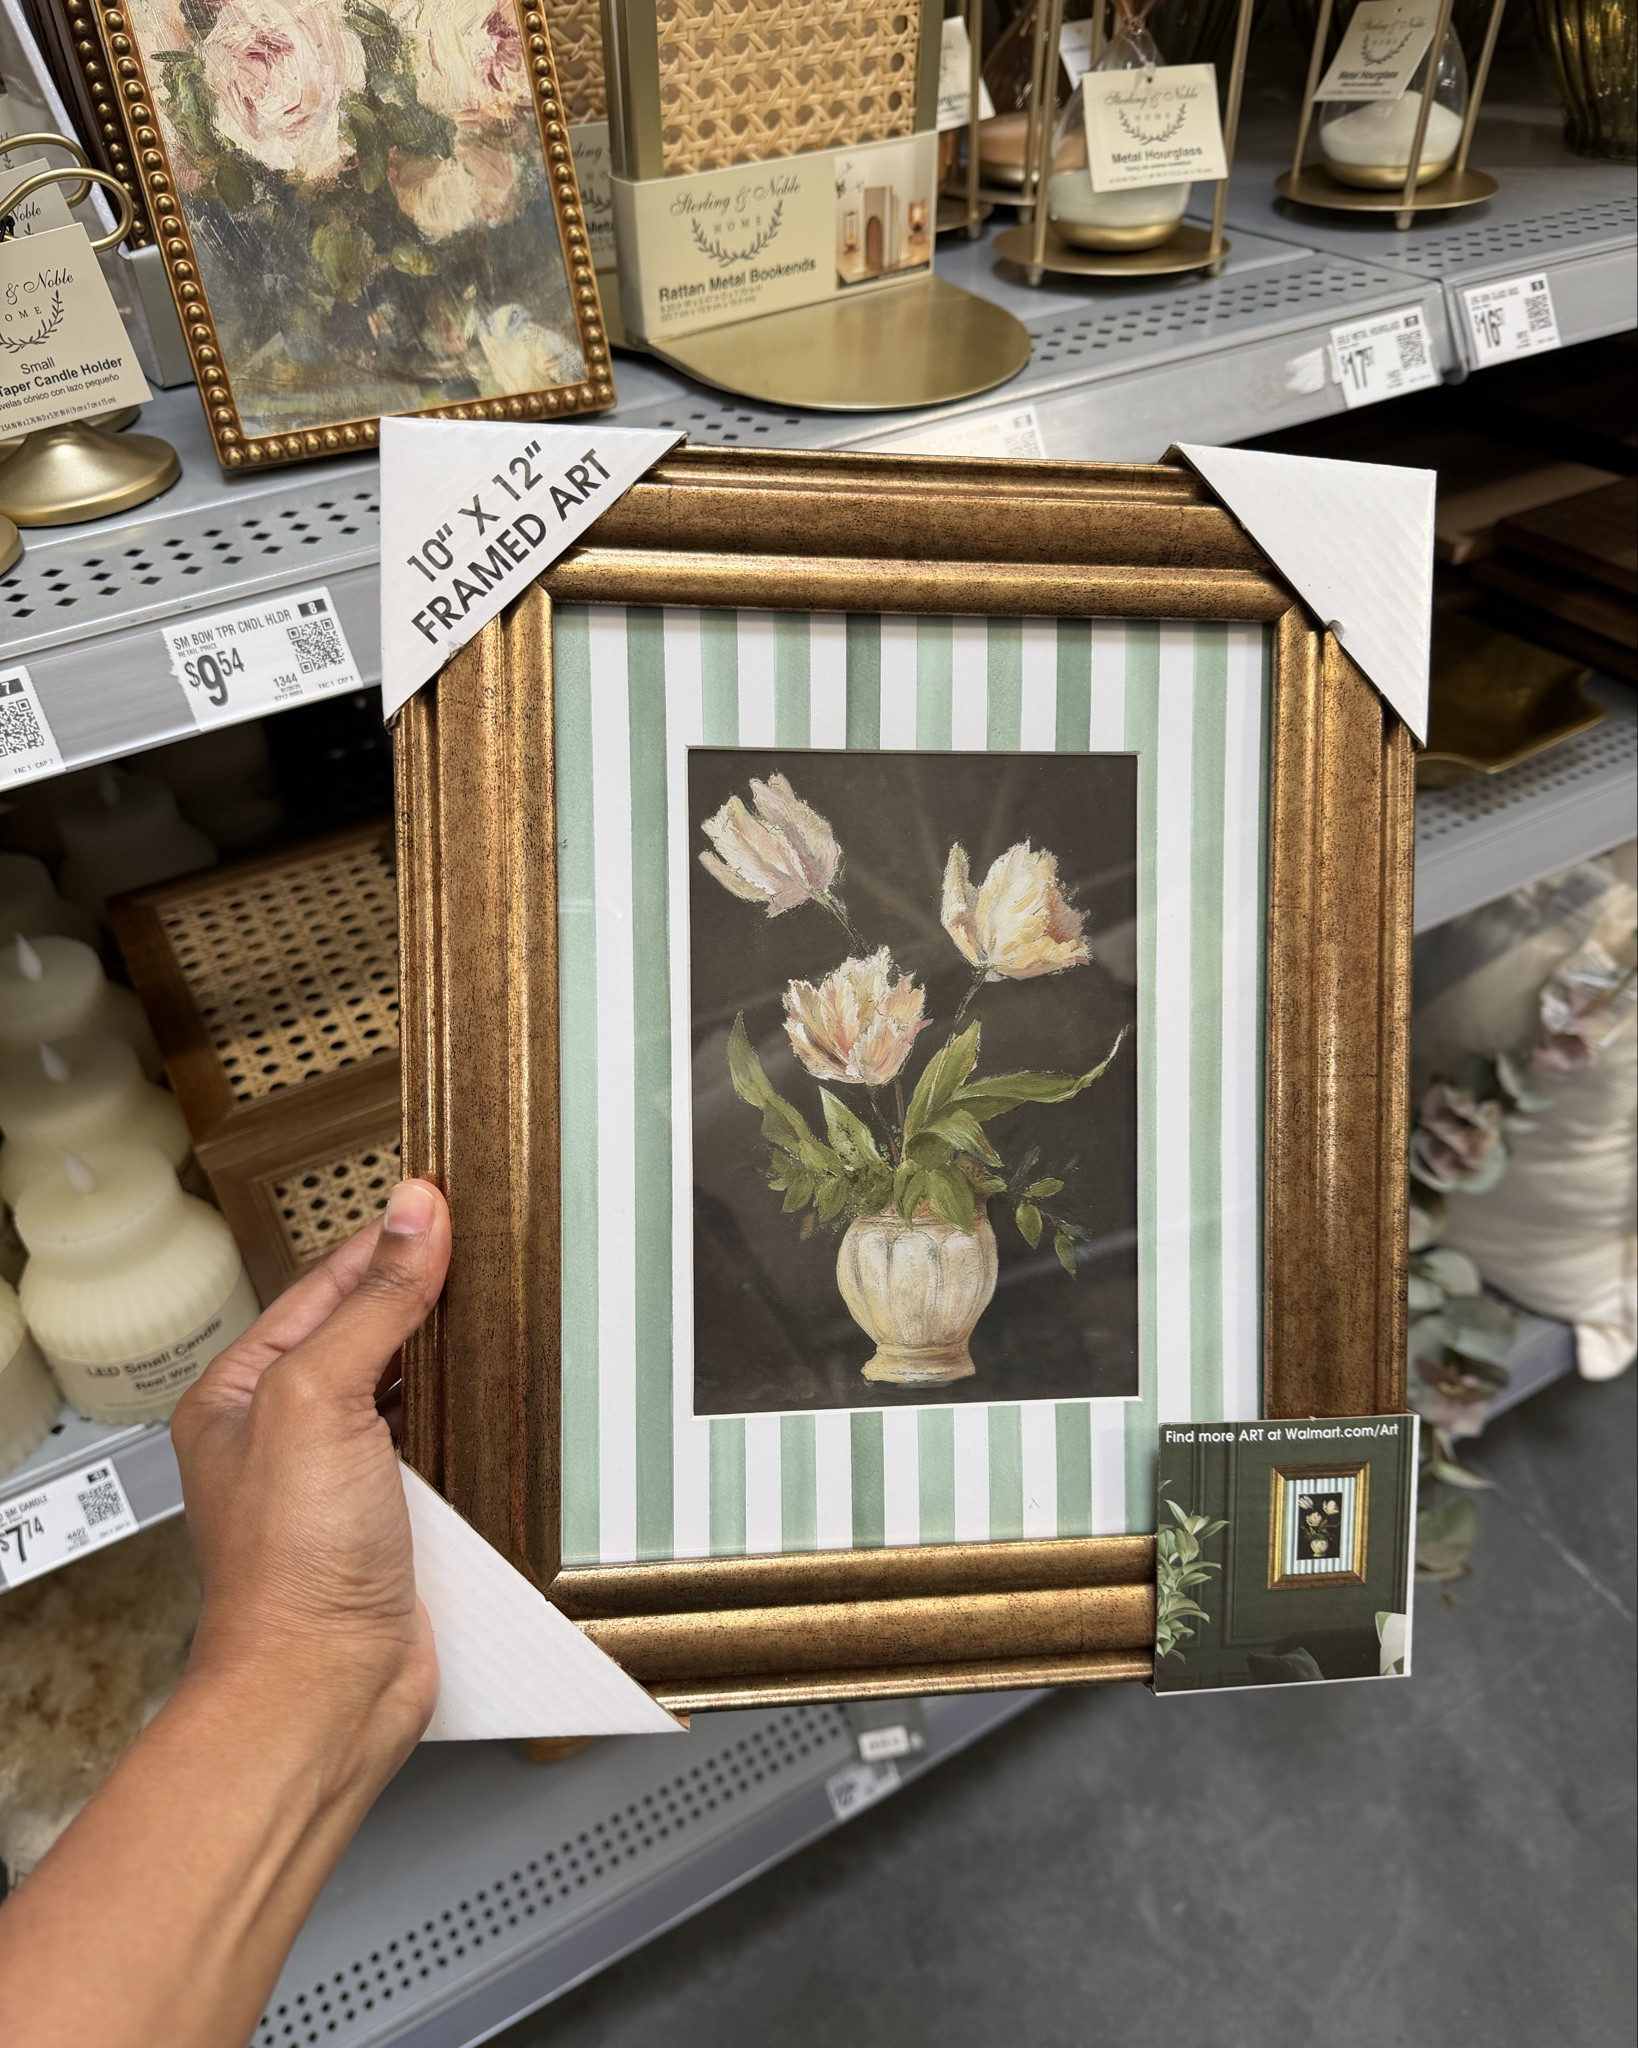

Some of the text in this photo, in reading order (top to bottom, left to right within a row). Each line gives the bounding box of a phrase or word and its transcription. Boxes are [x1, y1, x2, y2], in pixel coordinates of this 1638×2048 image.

[1111, 147, 1203, 164] Metal Hourglass
[669, 175, 800, 217] Sterling & Noble
[714, 215, 762, 234] HOME
[6, 268, 74, 306] & Noble
[659, 282, 705, 302] Rattan
[710, 271, 746, 291] Metal
[750, 257, 816, 283] Bookends
[5, 306, 42, 322] OME
[20, 357, 56, 375] Small
[34, 369, 79, 388] Candle
[80, 358, 122, 376] Holder
[0, 374, 120, 410] velas cónico con lazo pequeño
[406, 440, 542, 583] 10" X 12"
[410, 448, 612, 645] FRAMED ART
[308, 603, 317, 614] 8
[173, 609, 292, 650] SM BOW TPR CNDL HLDR
[178, 643, 218, 658] RETAIL PRICE
[1, 682, 10, 695] 7
[273, 673, 298, 688] 1344
[14, 766, 27, 775] FAC
[35, 760, 48, 769] CAP
[87, 1366, 120, 1378] LED
[124, 1352, 171, 1375] Small
[174, 1318, 222, 1355] Candle
[1166, 1423, 1399, 1443] Find more ART at Walmart.com/Art
